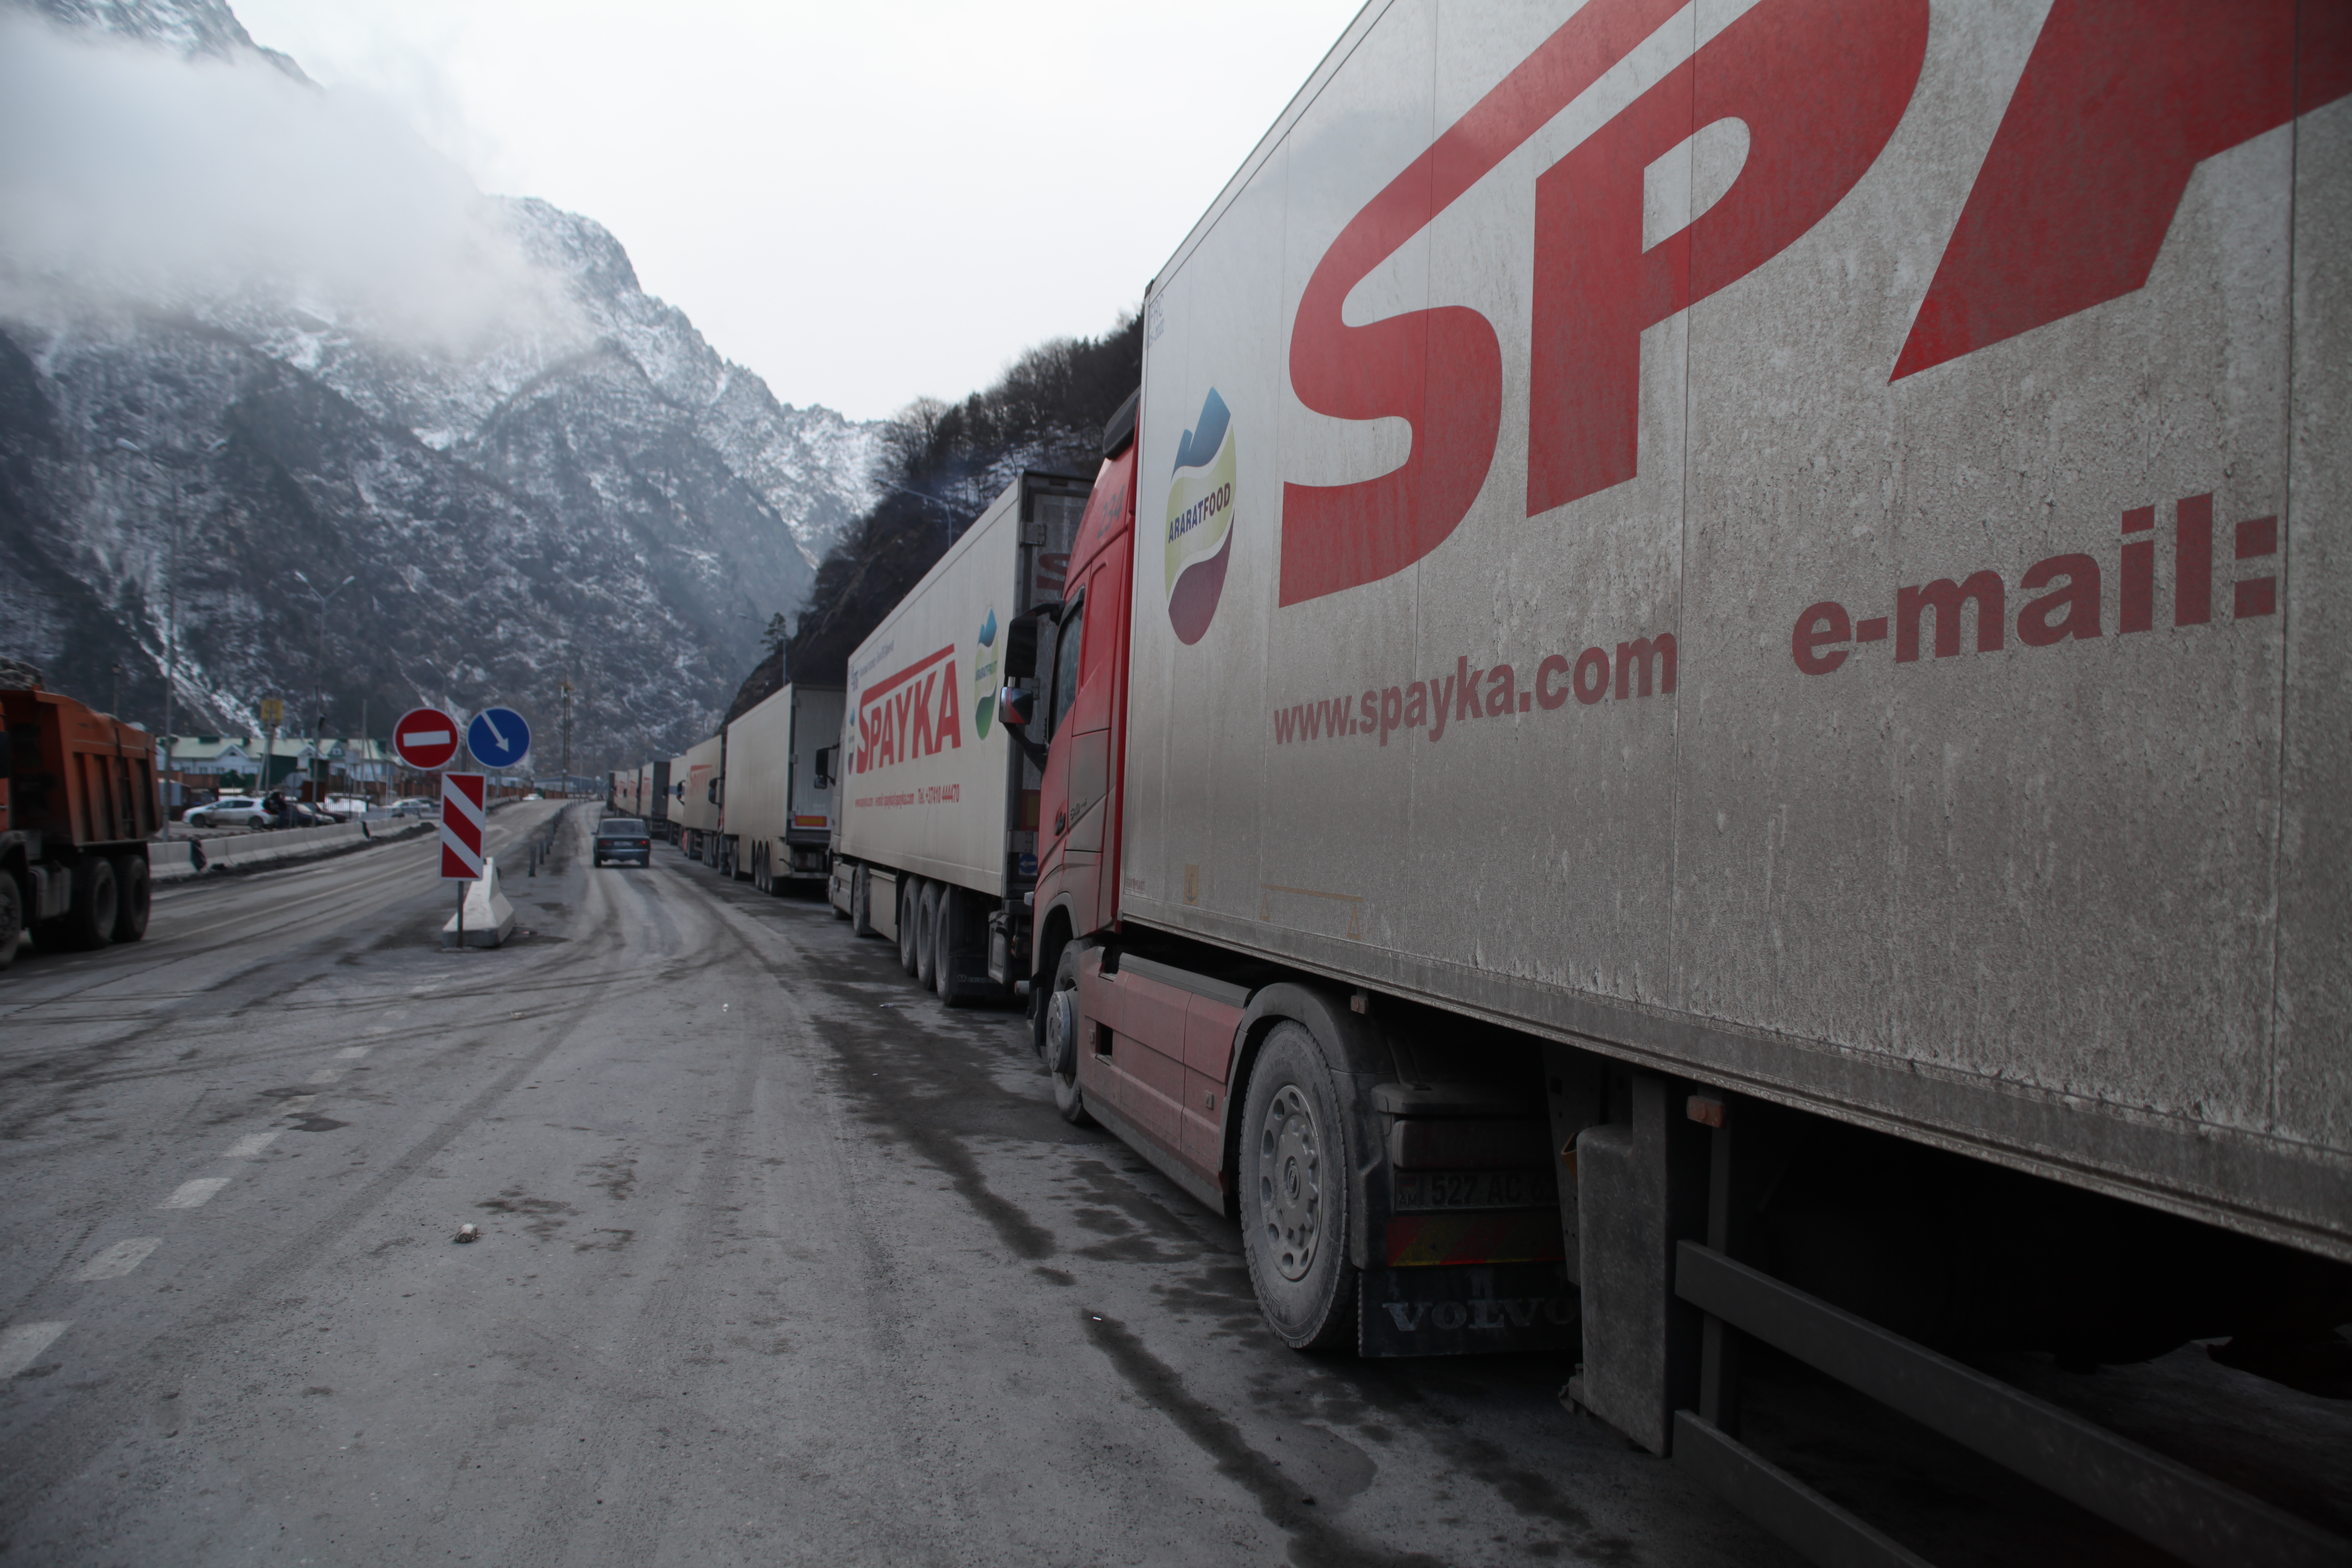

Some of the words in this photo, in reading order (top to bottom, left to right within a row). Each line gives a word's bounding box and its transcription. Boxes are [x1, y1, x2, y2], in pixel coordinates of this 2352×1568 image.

[1097, 483, 1126, 539] 234
[1168, 482, 1230, 544] ARARATFOOD
[1274, 632, 1675, 747] www.spayka.com
[1792, 492, 2277, 676] e-mail:
[856, 643, 961, 774] SPAYKA
[1398, 1192, 1418, 1206] AM
[1431, 1174, 1478, 1205] 527
[1486, 1174, 1522, 1204] AC
[1249, 1248, 1280, 1318] MICHELIN
[1382, 1296, 1577, 1332] VOLVO
